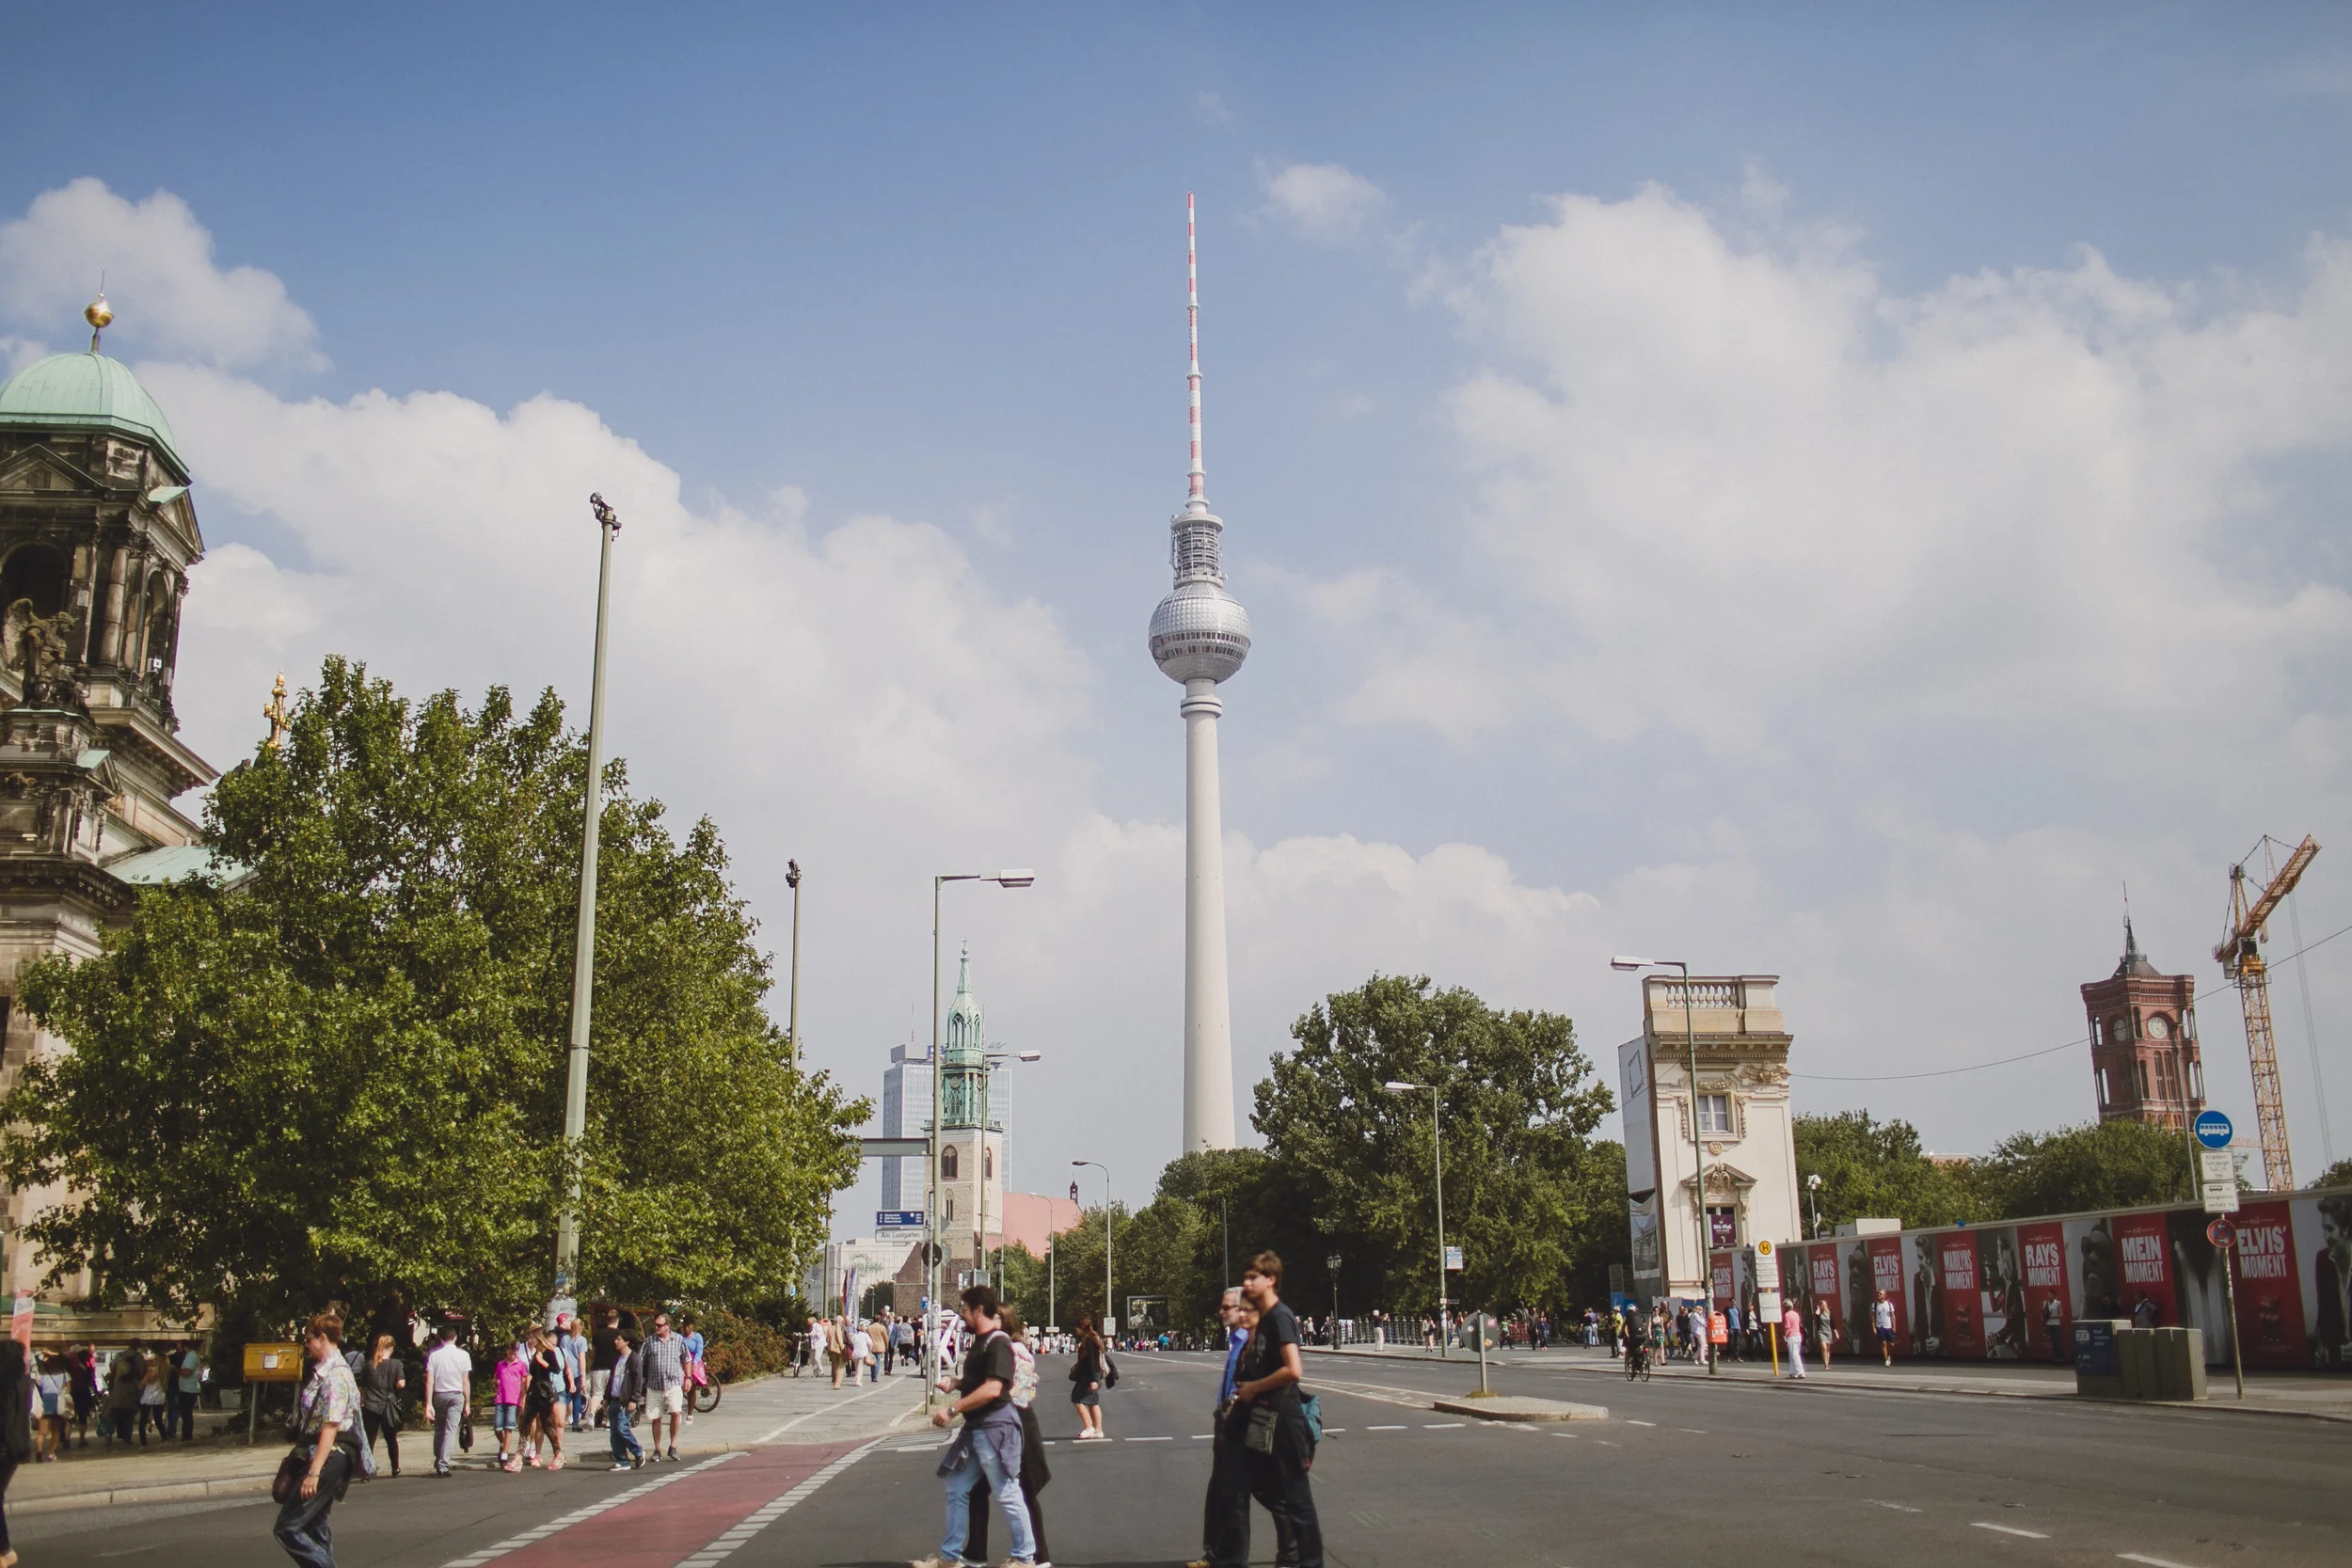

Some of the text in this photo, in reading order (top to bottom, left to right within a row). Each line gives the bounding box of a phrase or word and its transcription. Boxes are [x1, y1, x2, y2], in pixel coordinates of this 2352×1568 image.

[2025, 1243, 2059, 1267] RAYS
[2121, 1235, 2162, 1261] MEIN
[1813, 1259, 1835, 1278] RAYS
[2027, 1266, 2060, 1287] MOMENT
[2124, 1260, 2164, 1283] MOMENT
[2239, 1255, 2286, 1278] MOMENT
[1875, 1275, 1899, 1291] MOMENT
[1946, 1271, 1974, 1290] MOMENT
